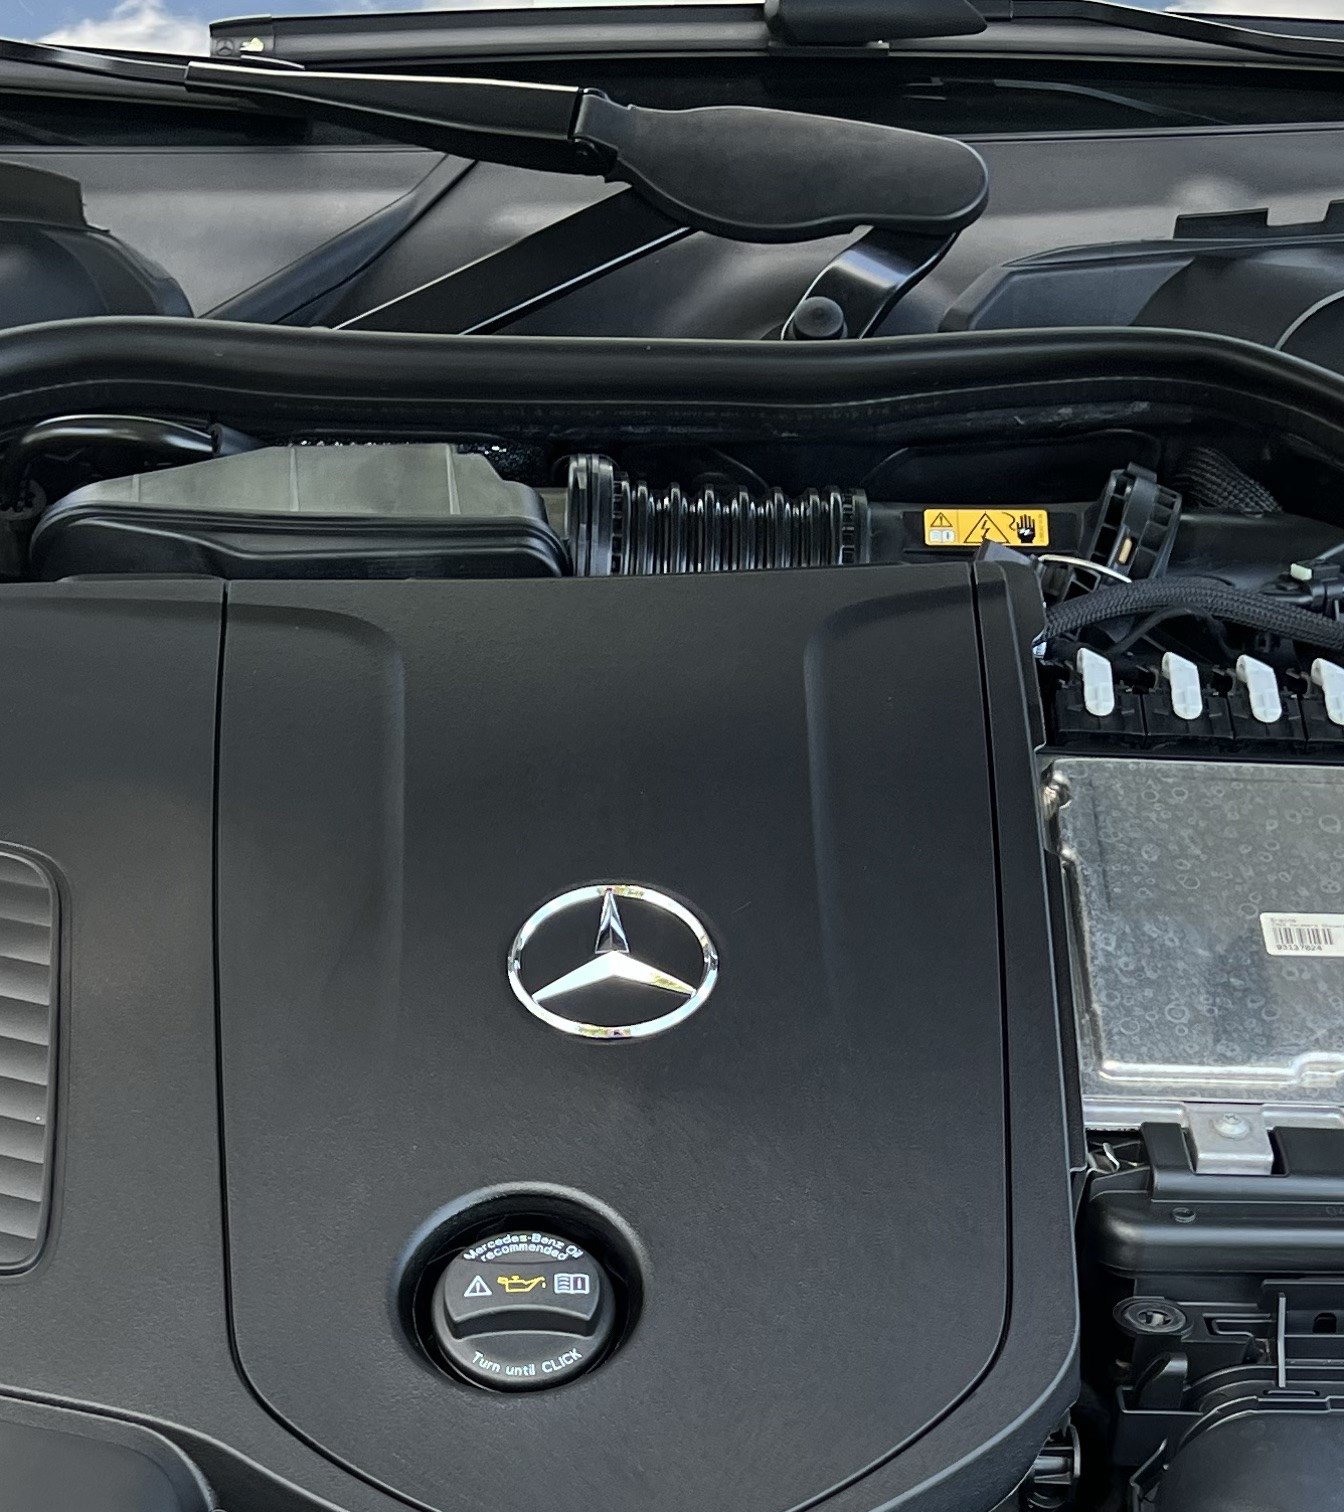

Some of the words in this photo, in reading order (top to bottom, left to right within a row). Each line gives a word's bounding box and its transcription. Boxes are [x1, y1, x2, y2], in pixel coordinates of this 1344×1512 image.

[463, 1232, 565, 1260] Mercedes-Benz
[565, 1245, 584, 1260] Oil
[480, 1242, 570, 1262] recommended
[471, 1350, 501, 1373] Turn
[505, 1362, 536, 1376] until
[541, 1347, 583, 1374] CLICK
